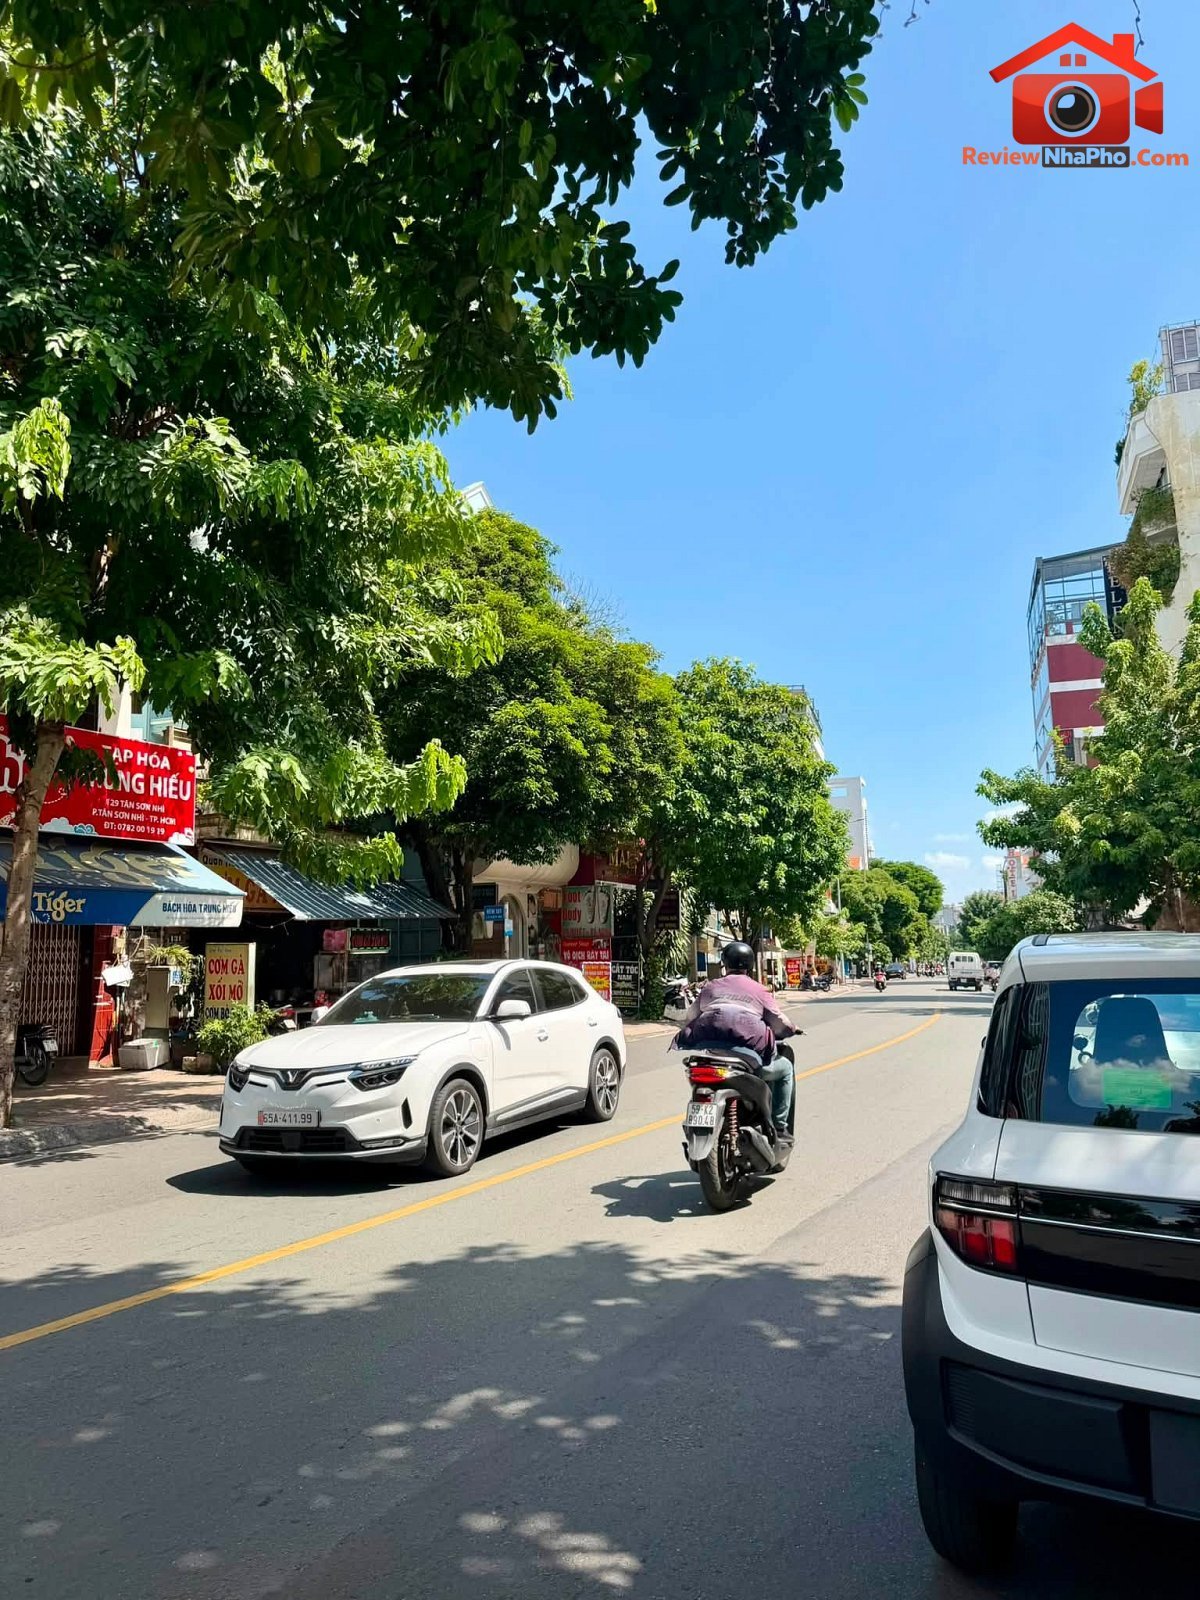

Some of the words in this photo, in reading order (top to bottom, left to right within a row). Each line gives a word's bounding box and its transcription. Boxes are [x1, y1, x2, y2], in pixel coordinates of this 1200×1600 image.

[137, 751, 171, 770] HÓA
[150, 772, 191, 801] HIẾU
[120, 799, 135, 809] TÂN
[136, 802, 151, 811] SƠN
[152, 804, 165, 813] NHÌ
[92, 808, 113, 817] P.TÂN
[114, 810, 129, 820] SƠN
[131, 812, 144, 821] NHÌ
[150, 815, 159, 824] TP.
[160, 817, 176, 825] HCM
[104, 821, 116, 830] ĐT:
[117, 823, 135, 832] 0782
[136, 825, 145, 833] 00
[33, 891, 86, 921] Tiger
[162, 900, 182, 912] BÁCH
[183, 901, 197, 913] HÓA
[198, 903, 221, 913] TRUNG
[231, 954, 245, 975] GÀ
[263, 1112, 312, 1124] 65A-411.99
